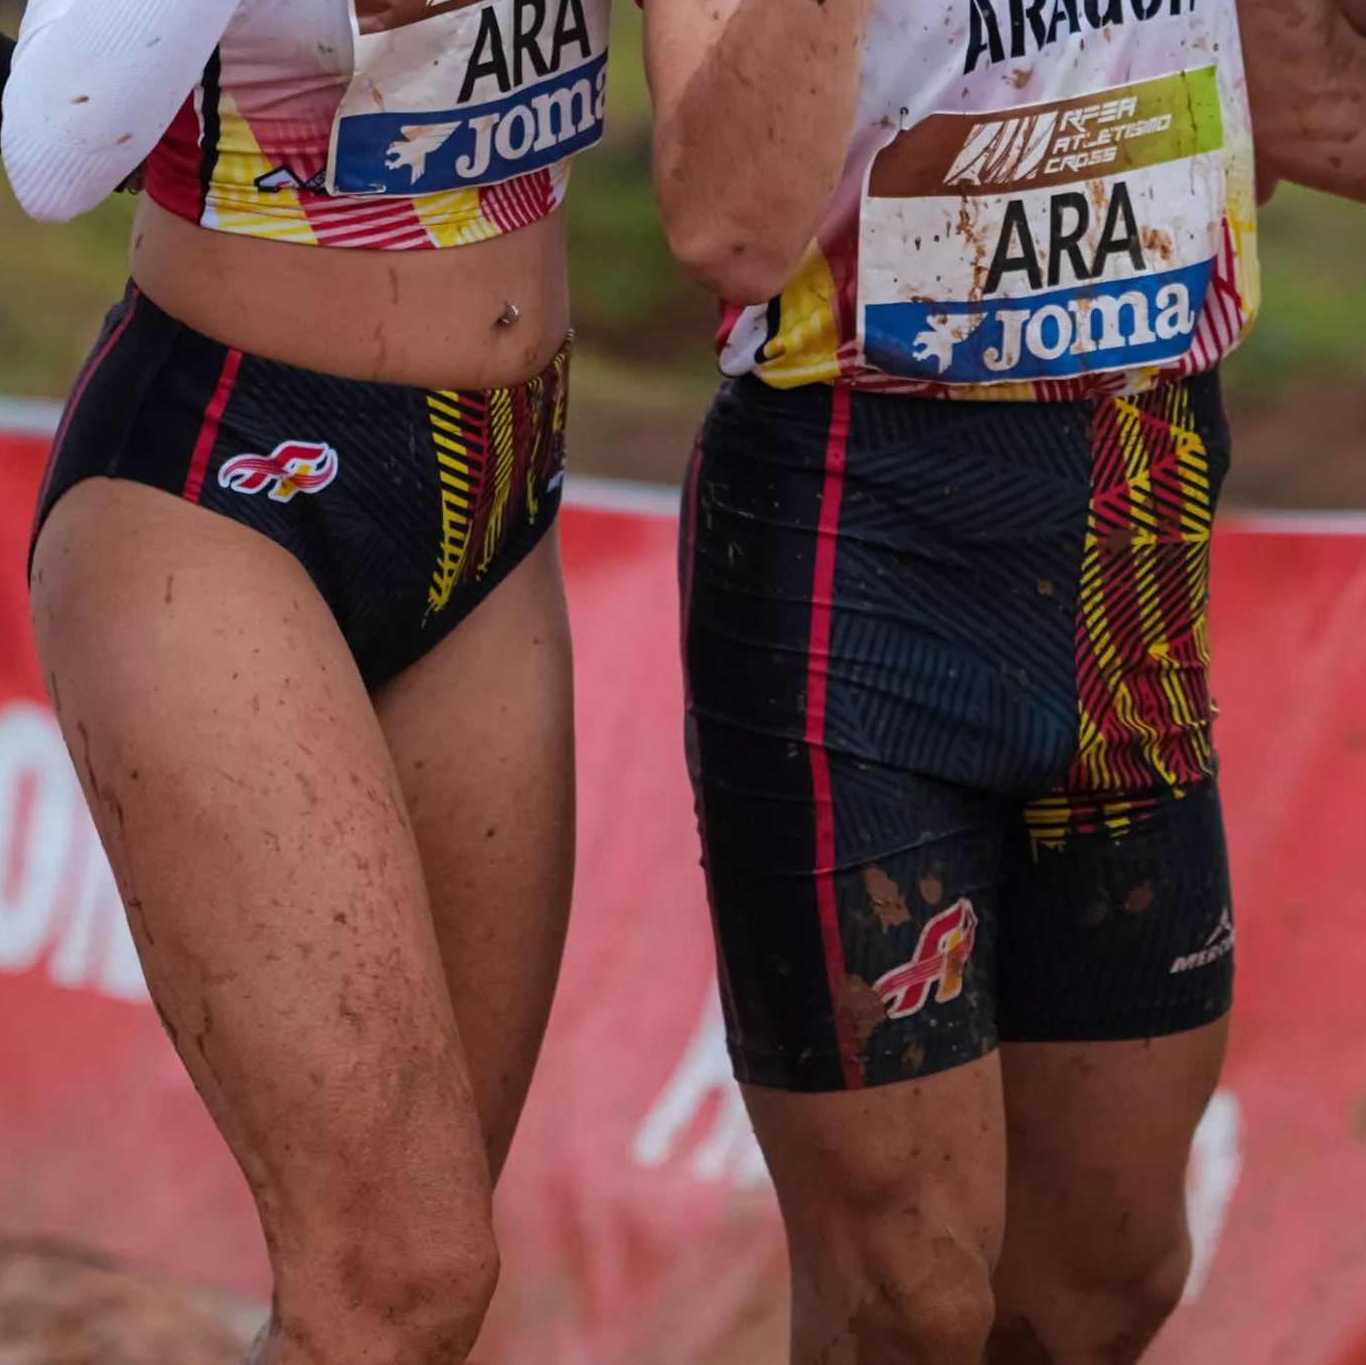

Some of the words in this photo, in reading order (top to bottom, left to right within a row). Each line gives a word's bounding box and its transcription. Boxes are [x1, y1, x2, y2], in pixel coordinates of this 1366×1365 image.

[1060, 96, 1137, 132] RFEA
[1044, 146, 1117, 173] CROSS
[984, 182, 1146, 294] ARA
